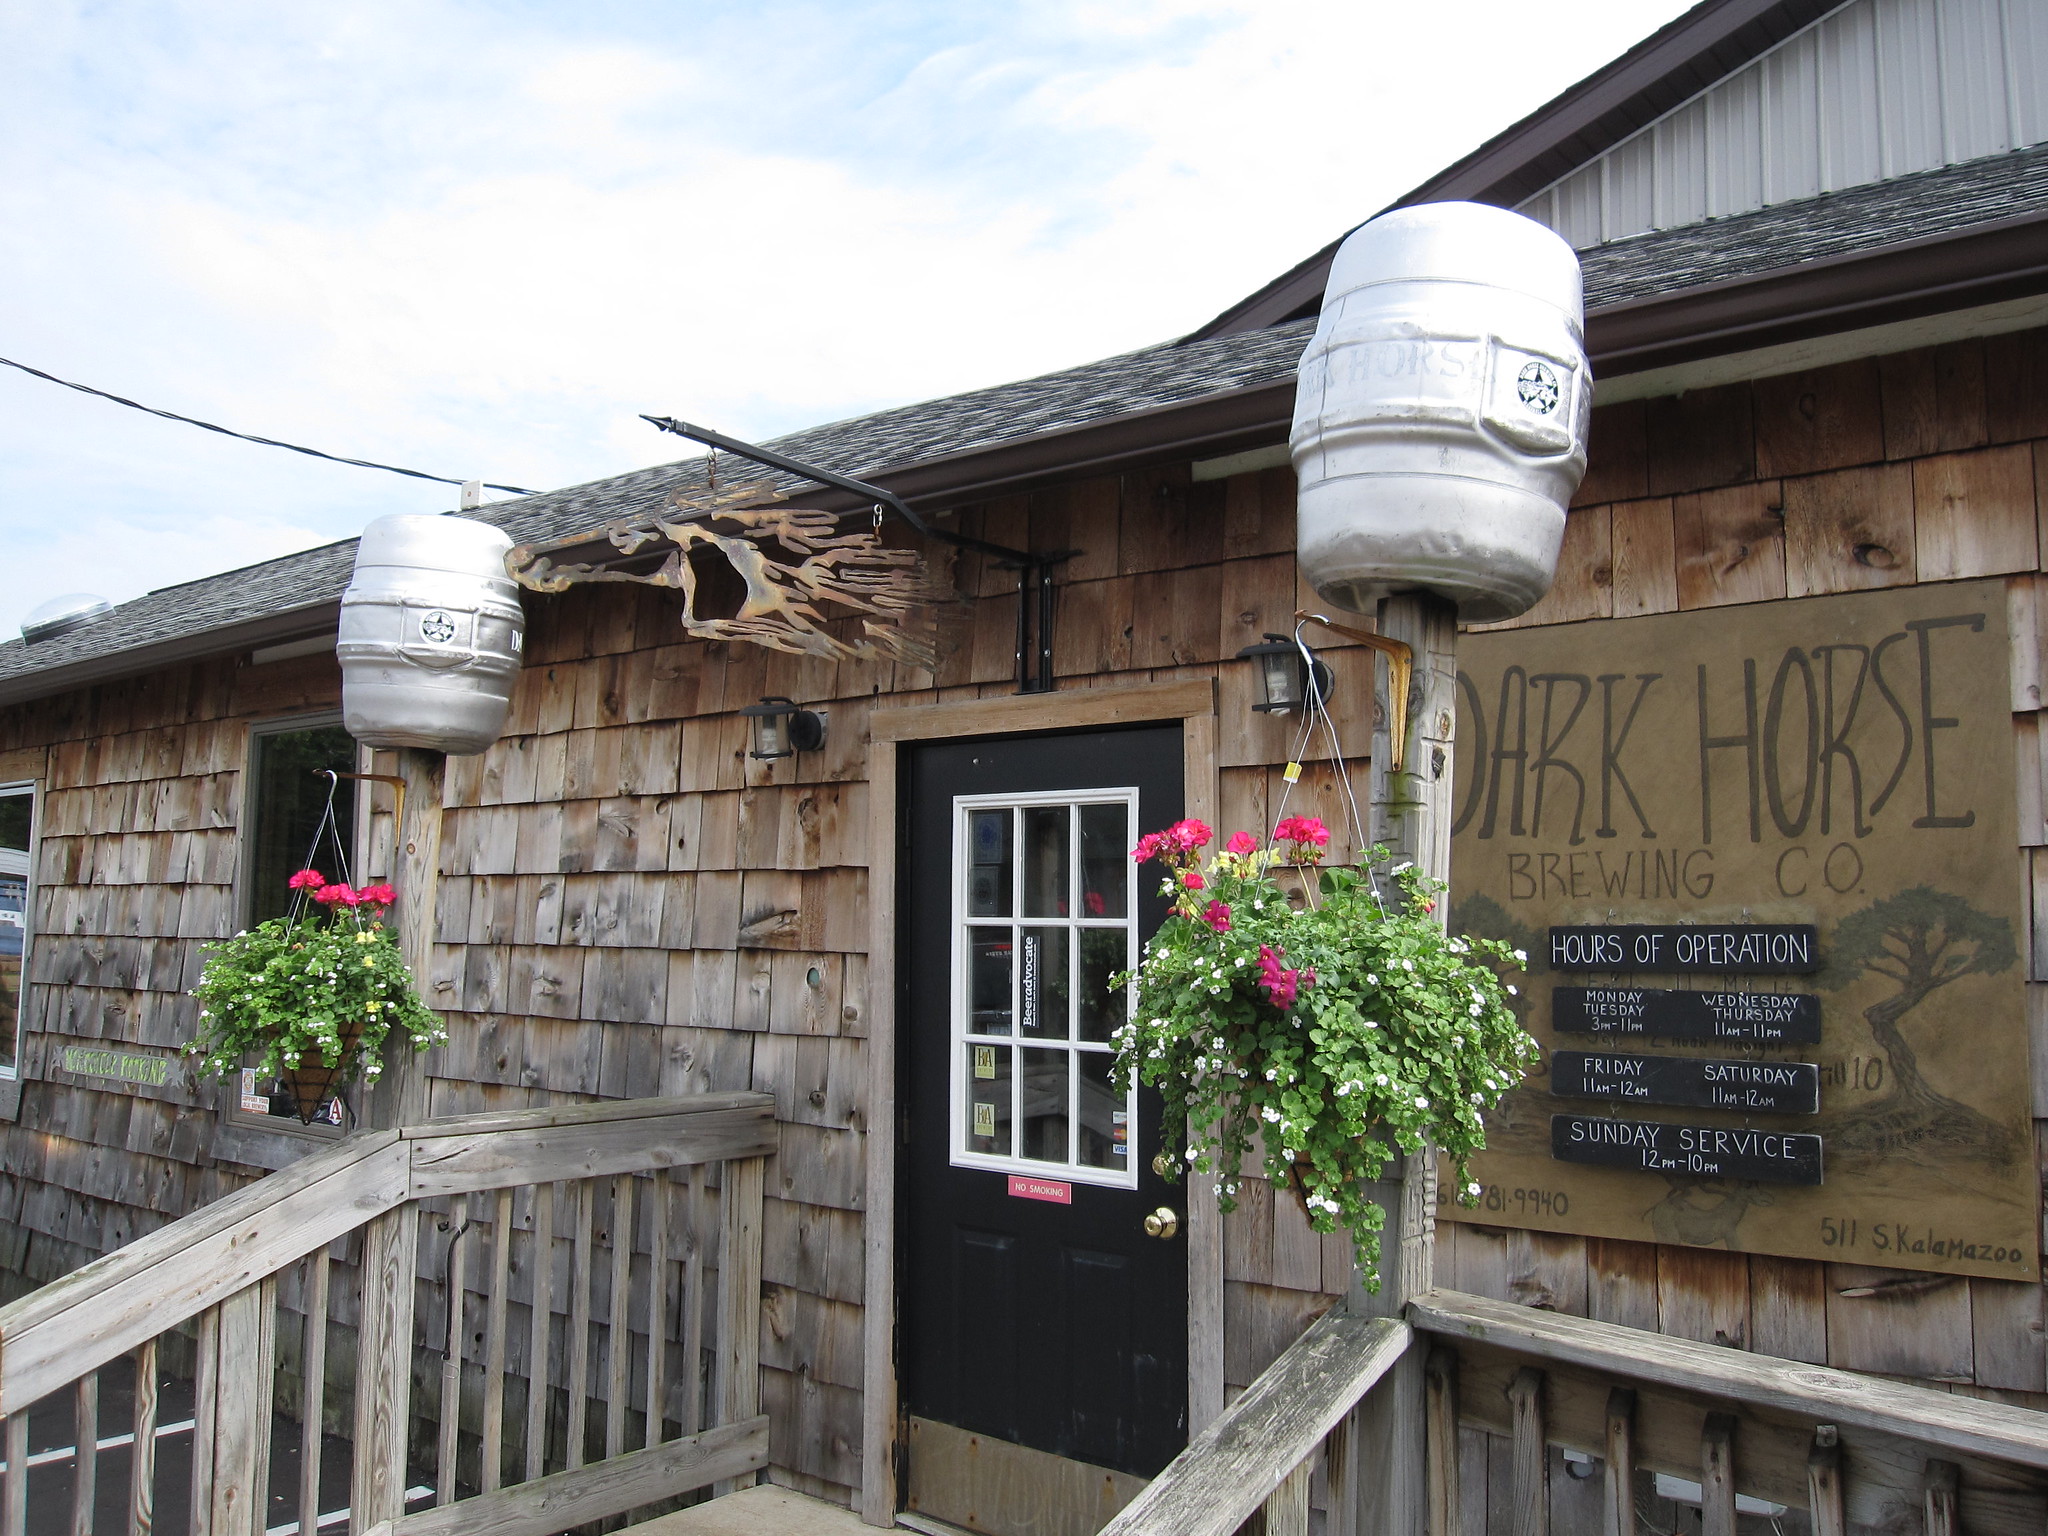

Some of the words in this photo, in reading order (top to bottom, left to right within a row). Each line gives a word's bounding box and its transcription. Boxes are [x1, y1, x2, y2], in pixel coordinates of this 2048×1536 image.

[1698, 612, 1986, 845] HORSE
[1508, 847, 1715, 902] BREWING
[1552, 934, 1624, 964] HOURS
[1634, 934, 1665, 964] OF
[1676, 933, 1809, 964] OPERATION
[1586, 990, 1644, 1003] MONDAY
[1701, 994, 1800, 1009] WEDNESDAY
[1583, 1003, 1646, 1017] TUESDAY
[1713, 1007, 1794, 1022] THURSDAY
[1584, 1058, 1645, 1076] FRIDAY
[1703, 1065, 1798, 1086] SATURDAY
[1852, 1055, 1883, 1091] 10
[1570, 1121, 1660, 1148] SUNDAY
[1679, 1128, 1796, 1159] SERVICE
[1015, 1182, 1027, 1192] NO
[1029, 1184, 1064, 1197] SMOKING
[1820, 1217, 1857, 1247] 511
